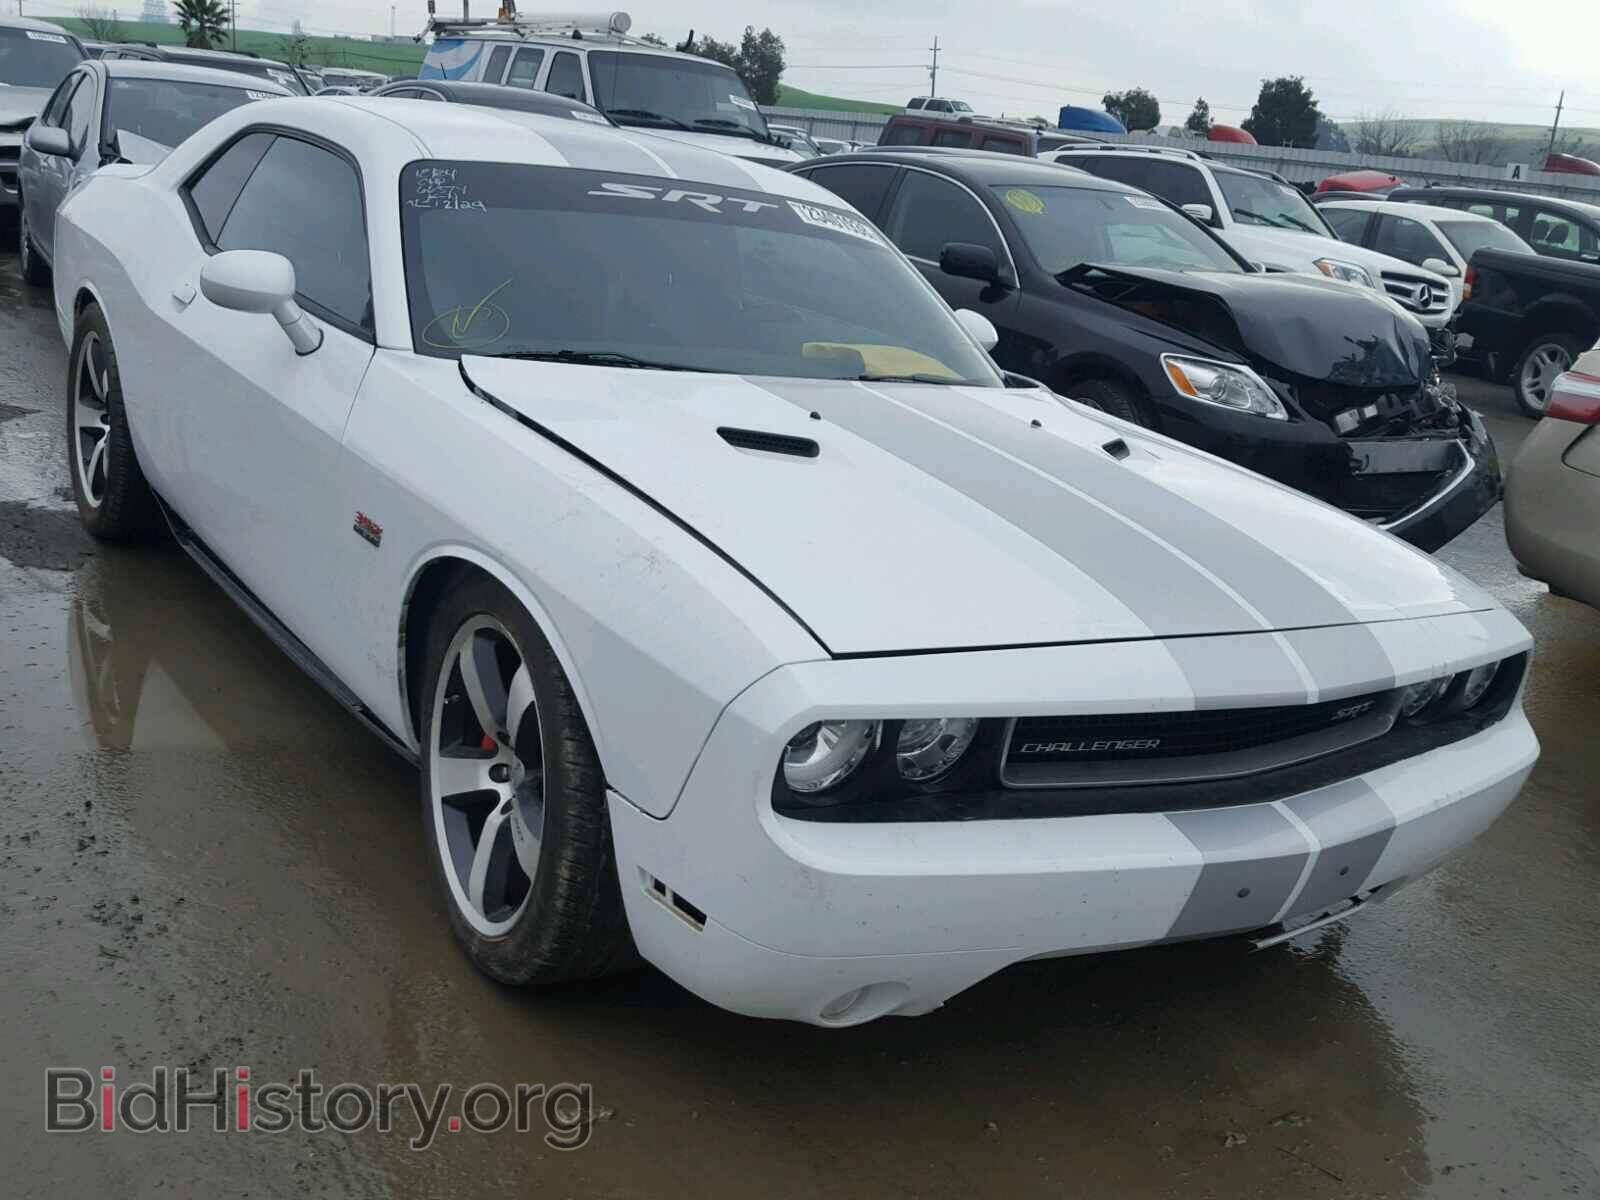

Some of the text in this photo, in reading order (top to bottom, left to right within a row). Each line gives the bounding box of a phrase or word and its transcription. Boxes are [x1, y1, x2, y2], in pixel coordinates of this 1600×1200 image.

[1511, 165, 1521, 180] A
[587, 182, 779, 213] SRT
[1330, 699, 1373, 720] SRT
[1020, 739, 1161, 753] CHALLENGER
